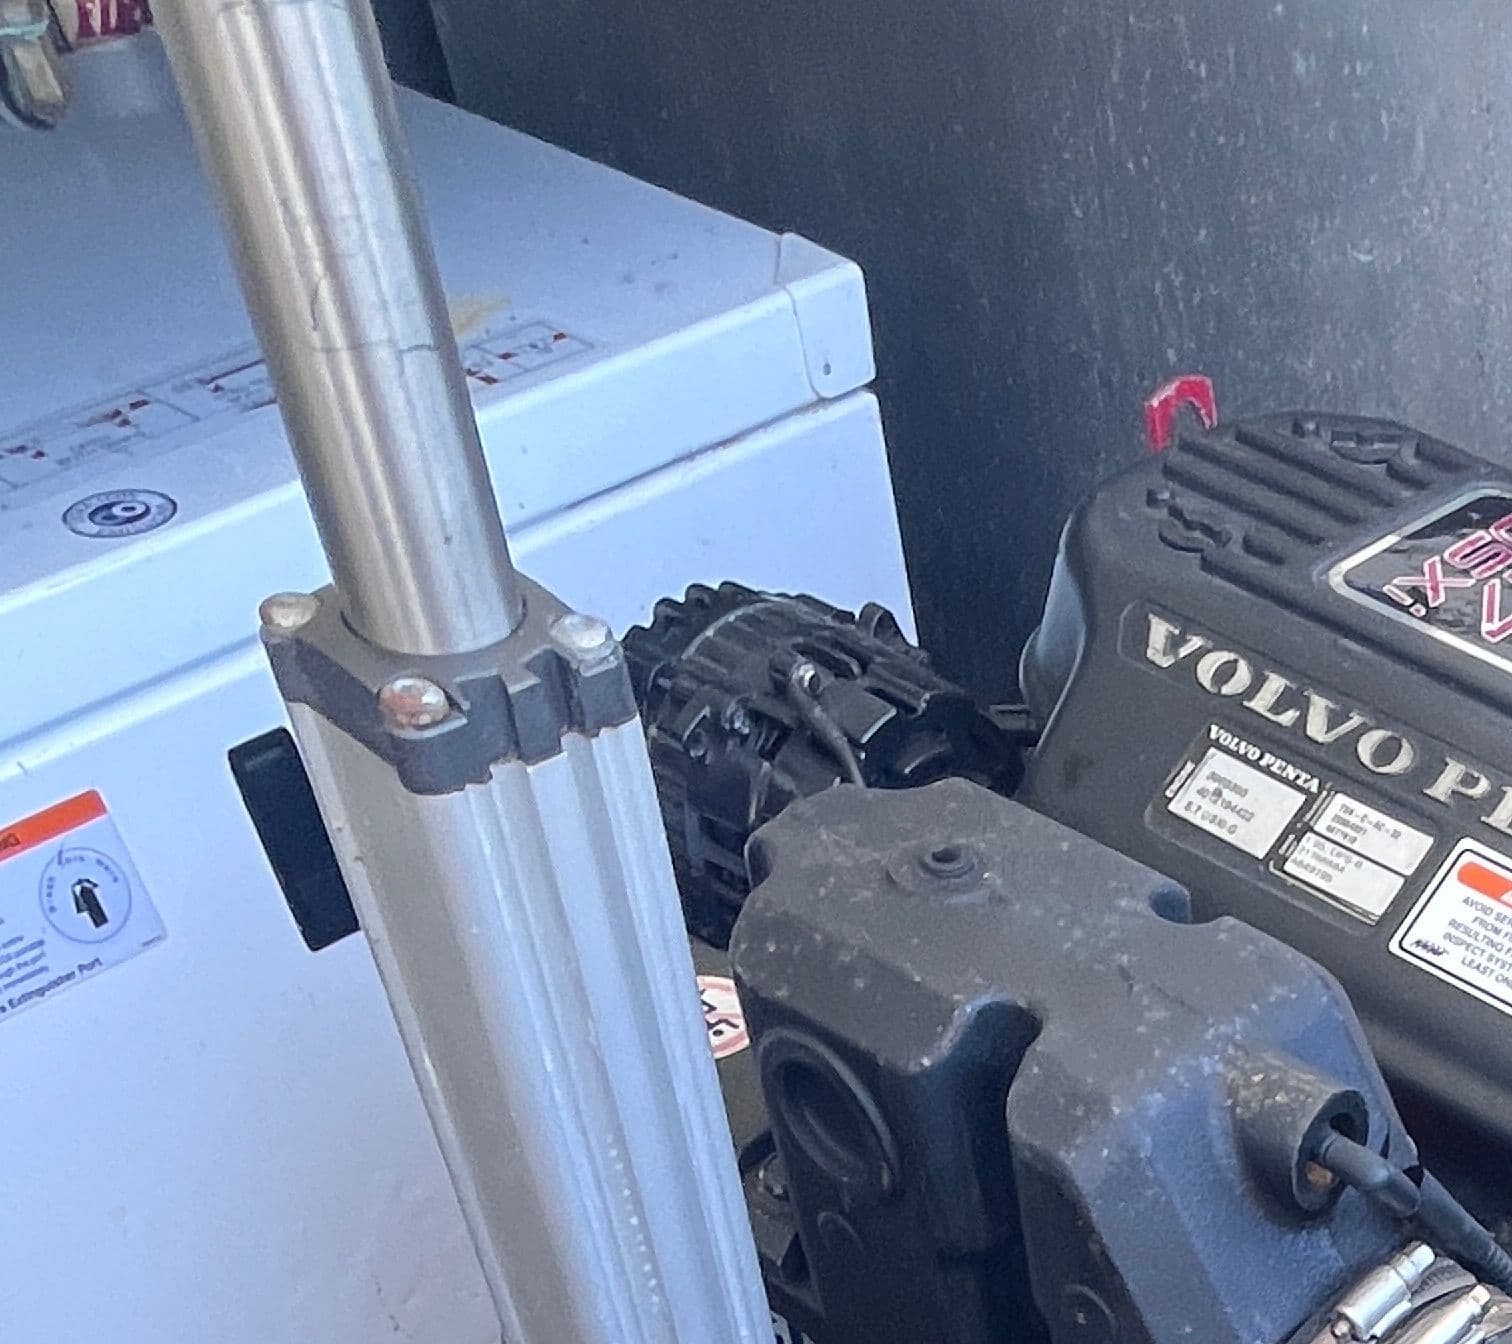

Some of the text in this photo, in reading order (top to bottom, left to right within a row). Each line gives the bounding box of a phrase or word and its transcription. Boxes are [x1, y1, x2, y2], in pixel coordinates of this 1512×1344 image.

[1145, 612, 1414, 775] VOLVO
[1207, 723, 1261, 761] VOLVO
[1259, 753, 1321, 793] PENTA
[1462, 896, 1494, 916] AVOID
[1448, 918, 1504, 955] RESULTING
[1471, 915, 1502, 936] FROM
[1442, 931, 1488, 960] INSPECT
[1461, 955, 1494, 978] LEAST
